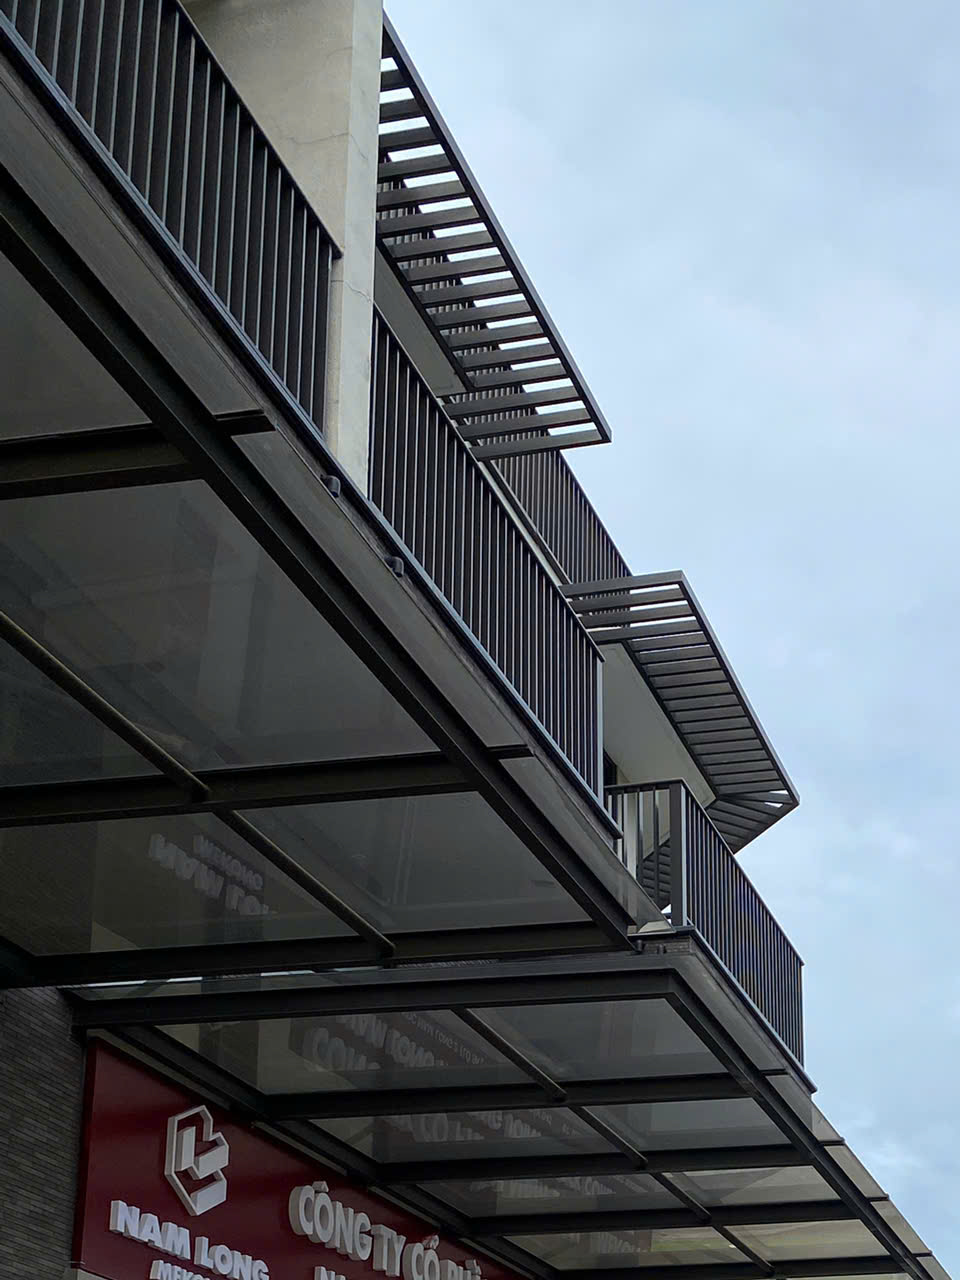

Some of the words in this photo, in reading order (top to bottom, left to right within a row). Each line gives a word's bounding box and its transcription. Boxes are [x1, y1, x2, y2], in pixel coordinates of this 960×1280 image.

[109, 1199, 191, 1260] NAM
[289, 1180, 373, 1261] CÔNG
[371, 1224, 407, 1277] TY
